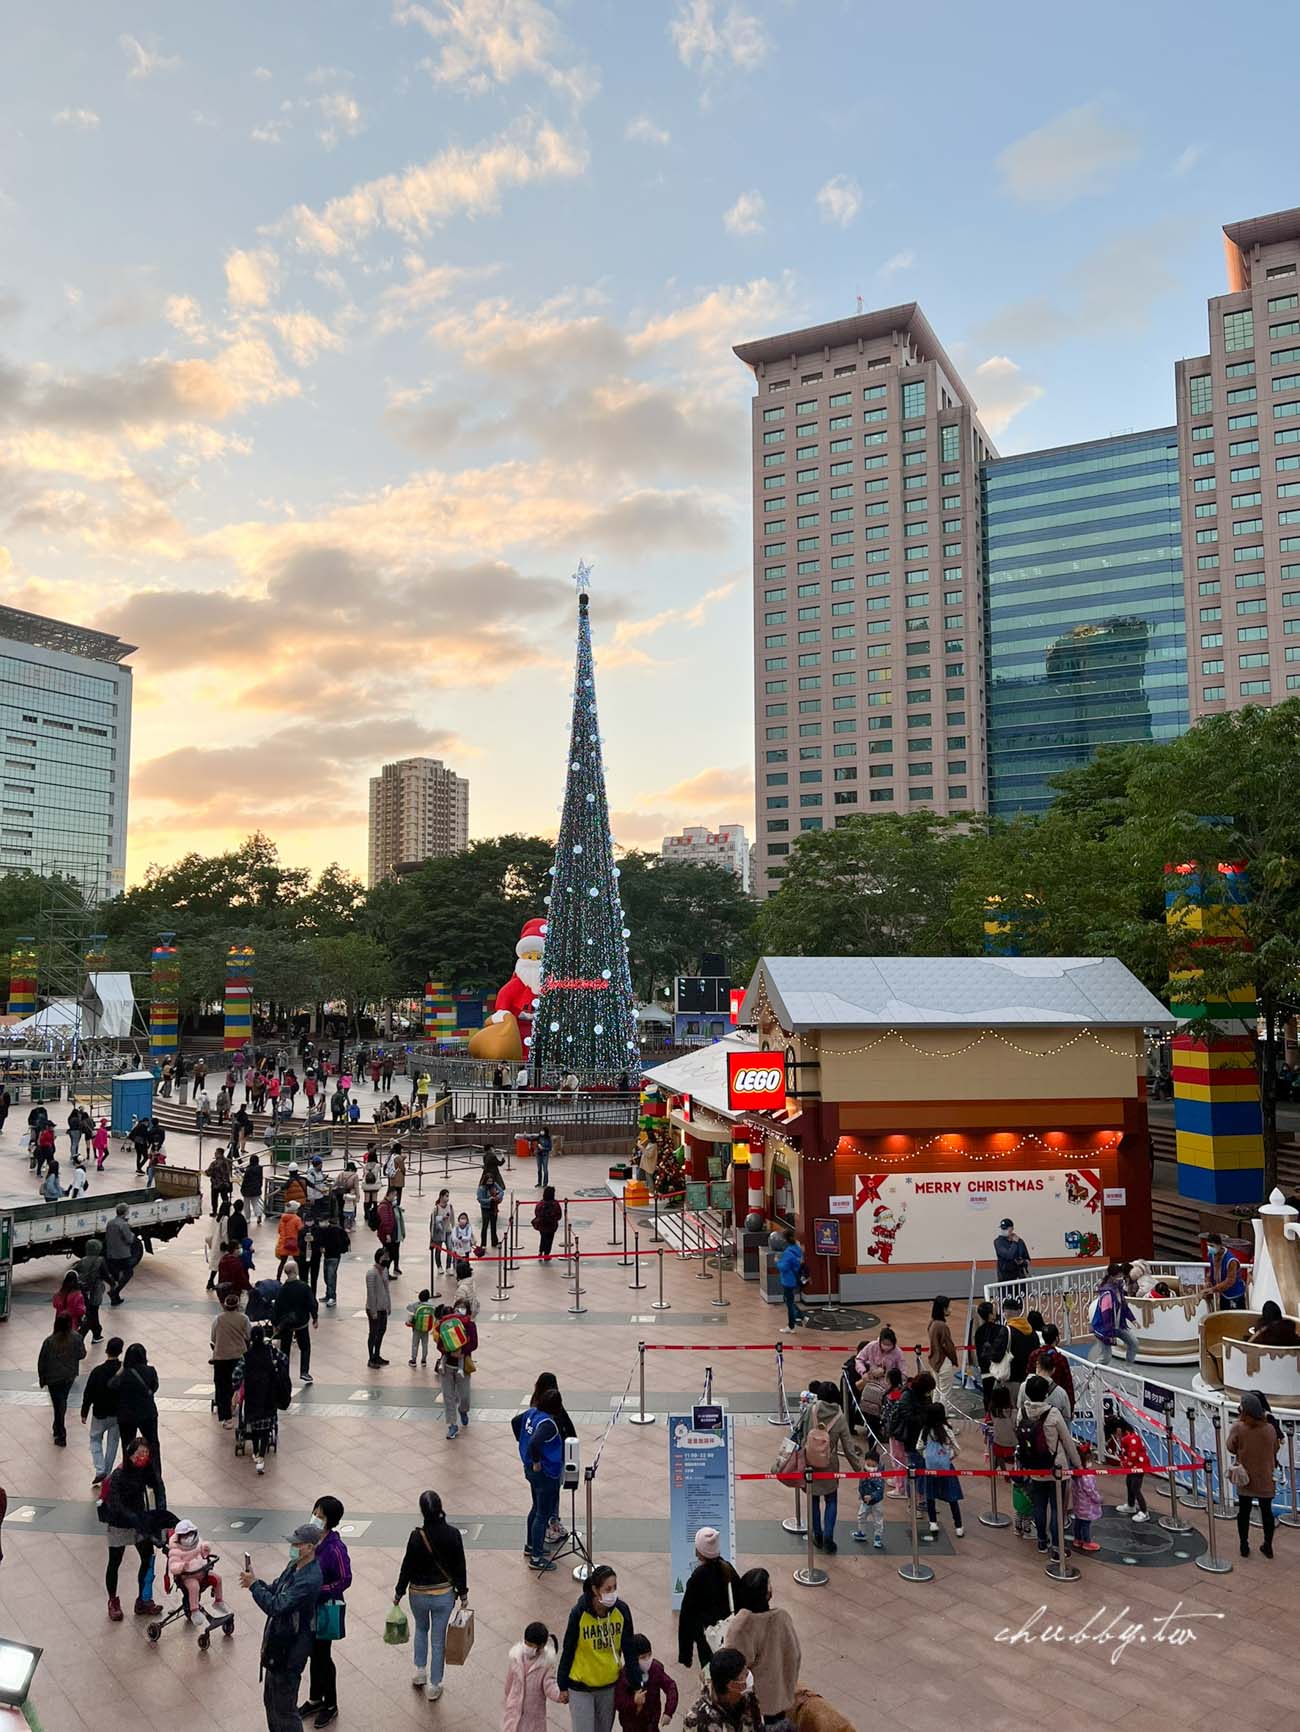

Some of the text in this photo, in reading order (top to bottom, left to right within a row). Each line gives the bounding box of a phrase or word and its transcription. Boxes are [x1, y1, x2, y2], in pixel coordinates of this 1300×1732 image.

[734, 1069, 781, 1092] LEGO
[915, 1178, 1044, 1194] MERRY CHRISTMAS
